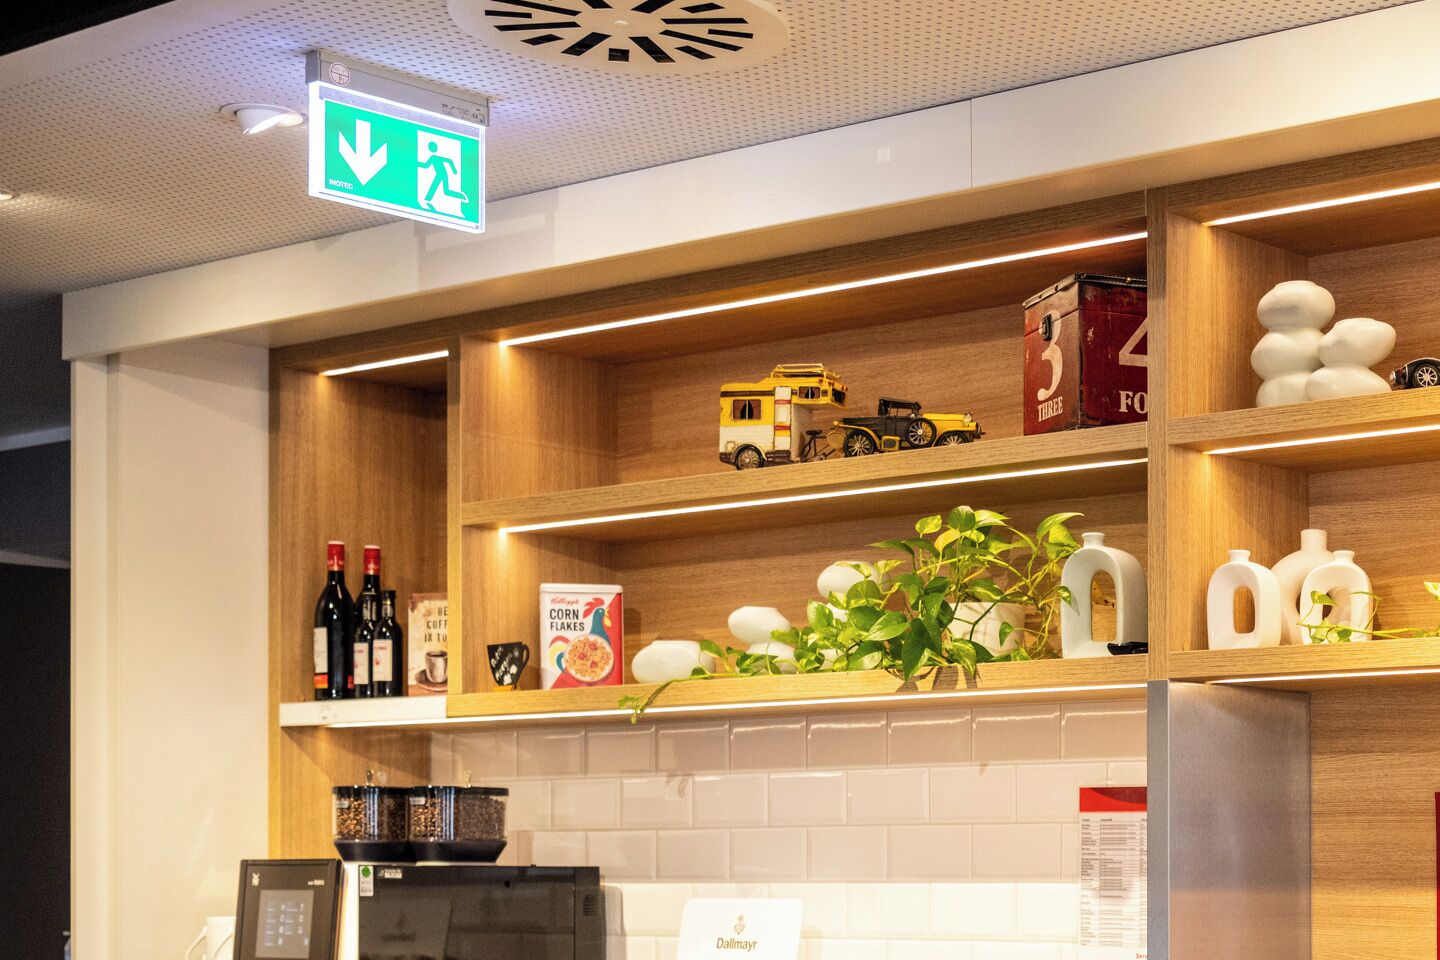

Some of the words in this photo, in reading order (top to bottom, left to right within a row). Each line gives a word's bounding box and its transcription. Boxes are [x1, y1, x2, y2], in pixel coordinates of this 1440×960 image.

[329, 178, 354, 190] INOTEC
[1037, 309, 1063, 402] 3
[1038, 396, 1063, 422] THREE
[550, 608, 579, 620] CORN
[550, 622, 585, 632] FLAKES
[716, 937, 758, 952] Dallmayr
